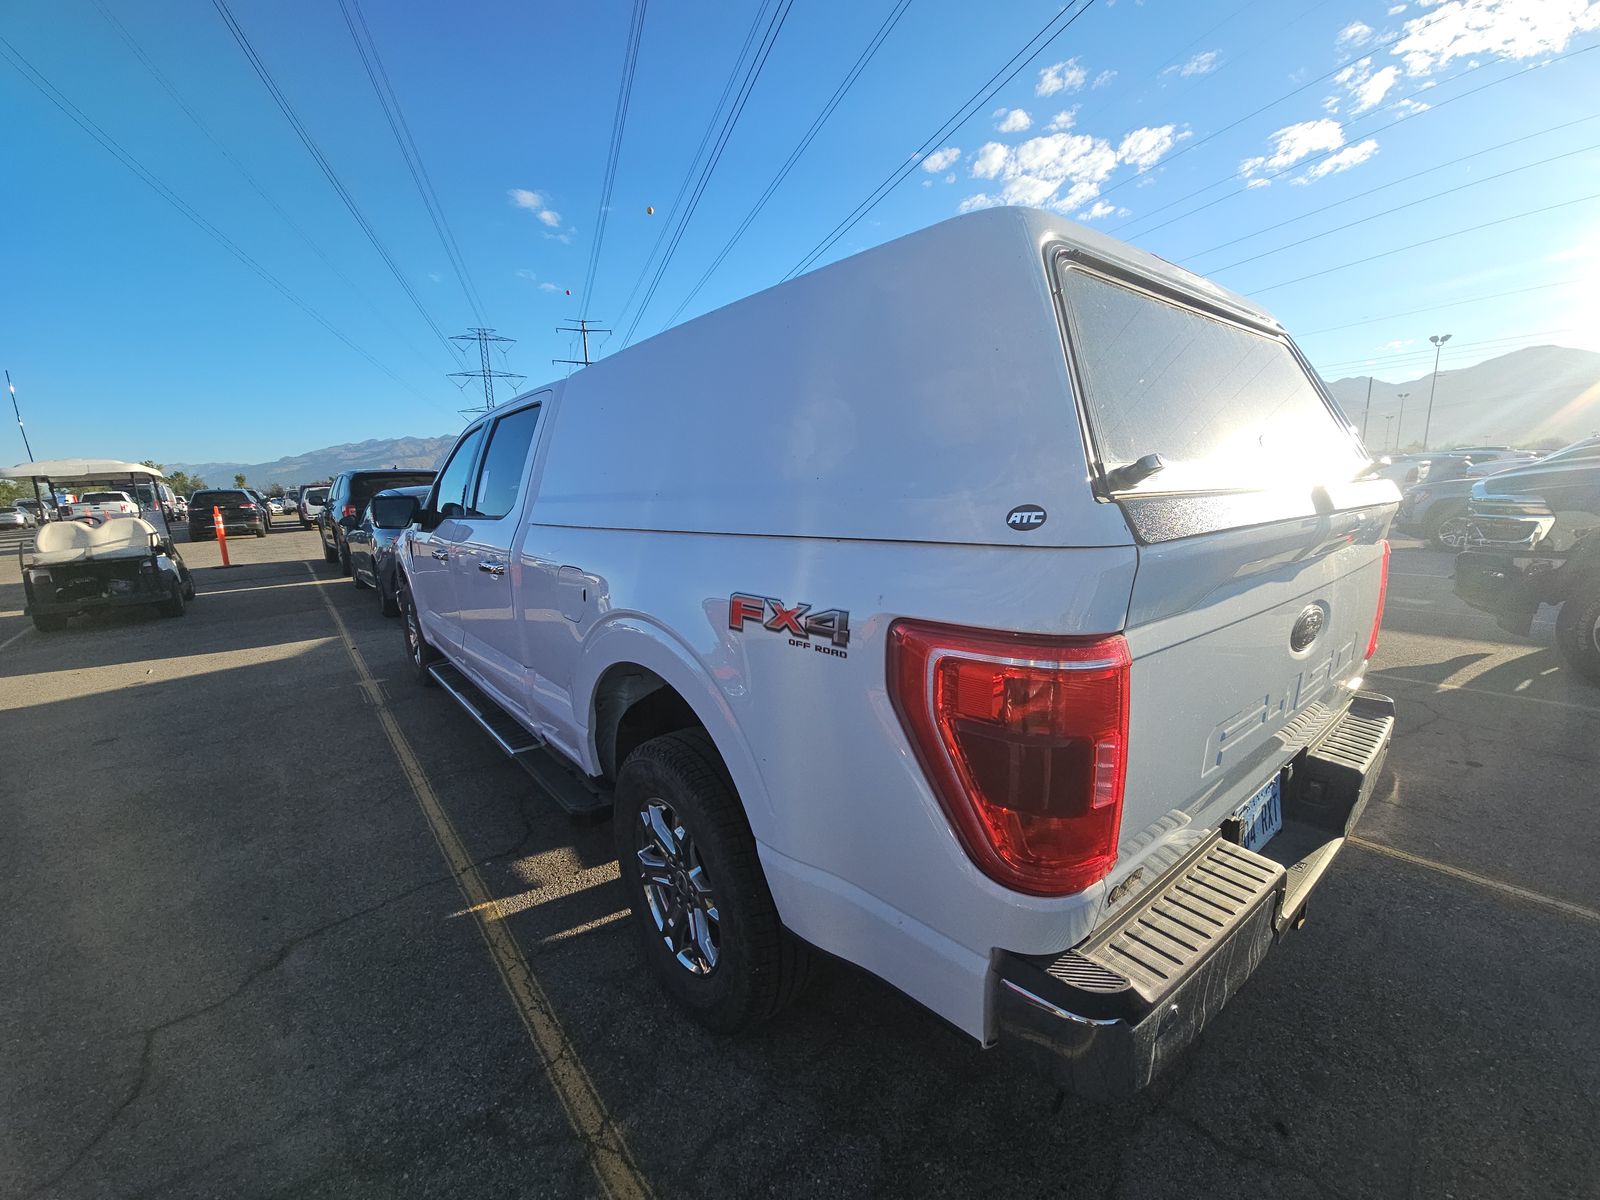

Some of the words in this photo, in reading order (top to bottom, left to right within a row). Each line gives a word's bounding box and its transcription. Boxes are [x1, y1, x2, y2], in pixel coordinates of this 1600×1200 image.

[1007, 511, 1044, 524] ATC
[729, 592, 850, 648] FX4
[788, 639, 811, 649] OFF
[815, 645, 848, 659] ROAD
[1261, 793, 1278, 834] RXT
